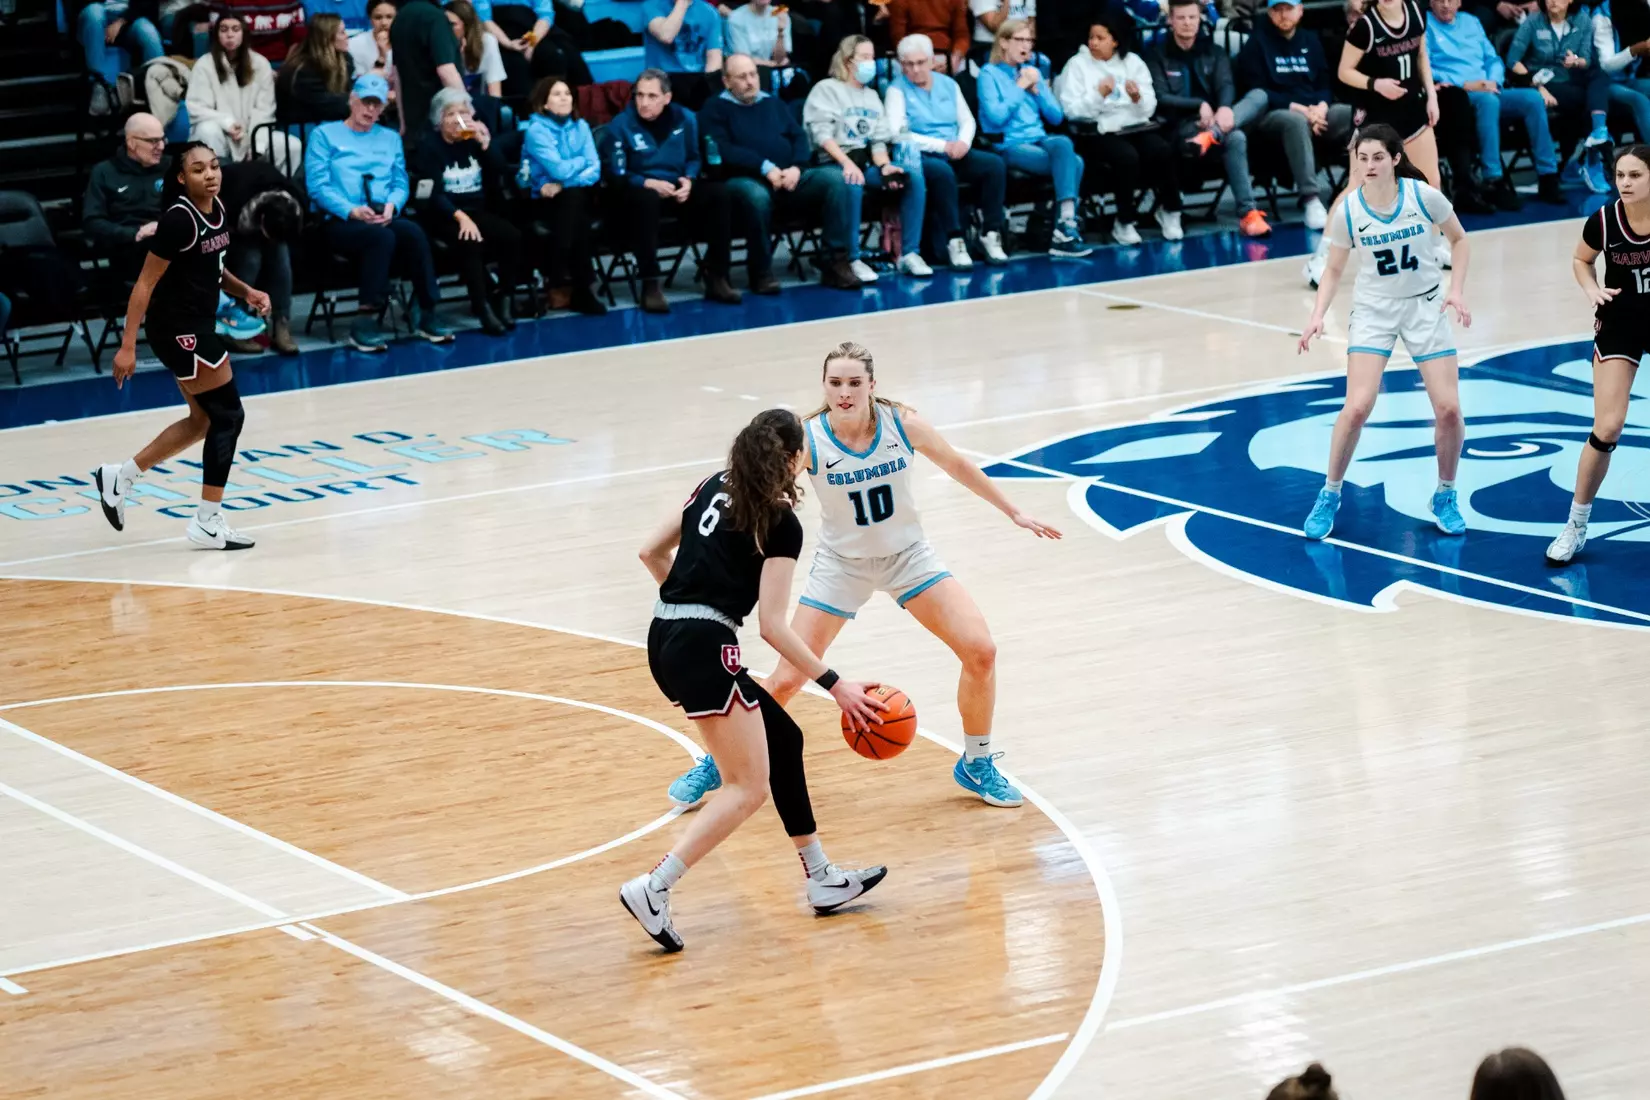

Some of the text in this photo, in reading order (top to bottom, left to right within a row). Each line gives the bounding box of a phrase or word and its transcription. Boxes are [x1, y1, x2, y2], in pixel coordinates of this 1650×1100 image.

[1397, 53, 1411, 80] 11
[1360, 224, 1425, 246] COLUMBIA
[1372, 244, 1419, 276] 24
[1631, 267, 1650, 293] 12
[827, 457, 907, 486] COLUMBIA
[156, 473, 420, 519] COURT
[847, 483, 894, 526] 10
[698, 492, 733, 537] 6
[727, 648, 741, 666] H
